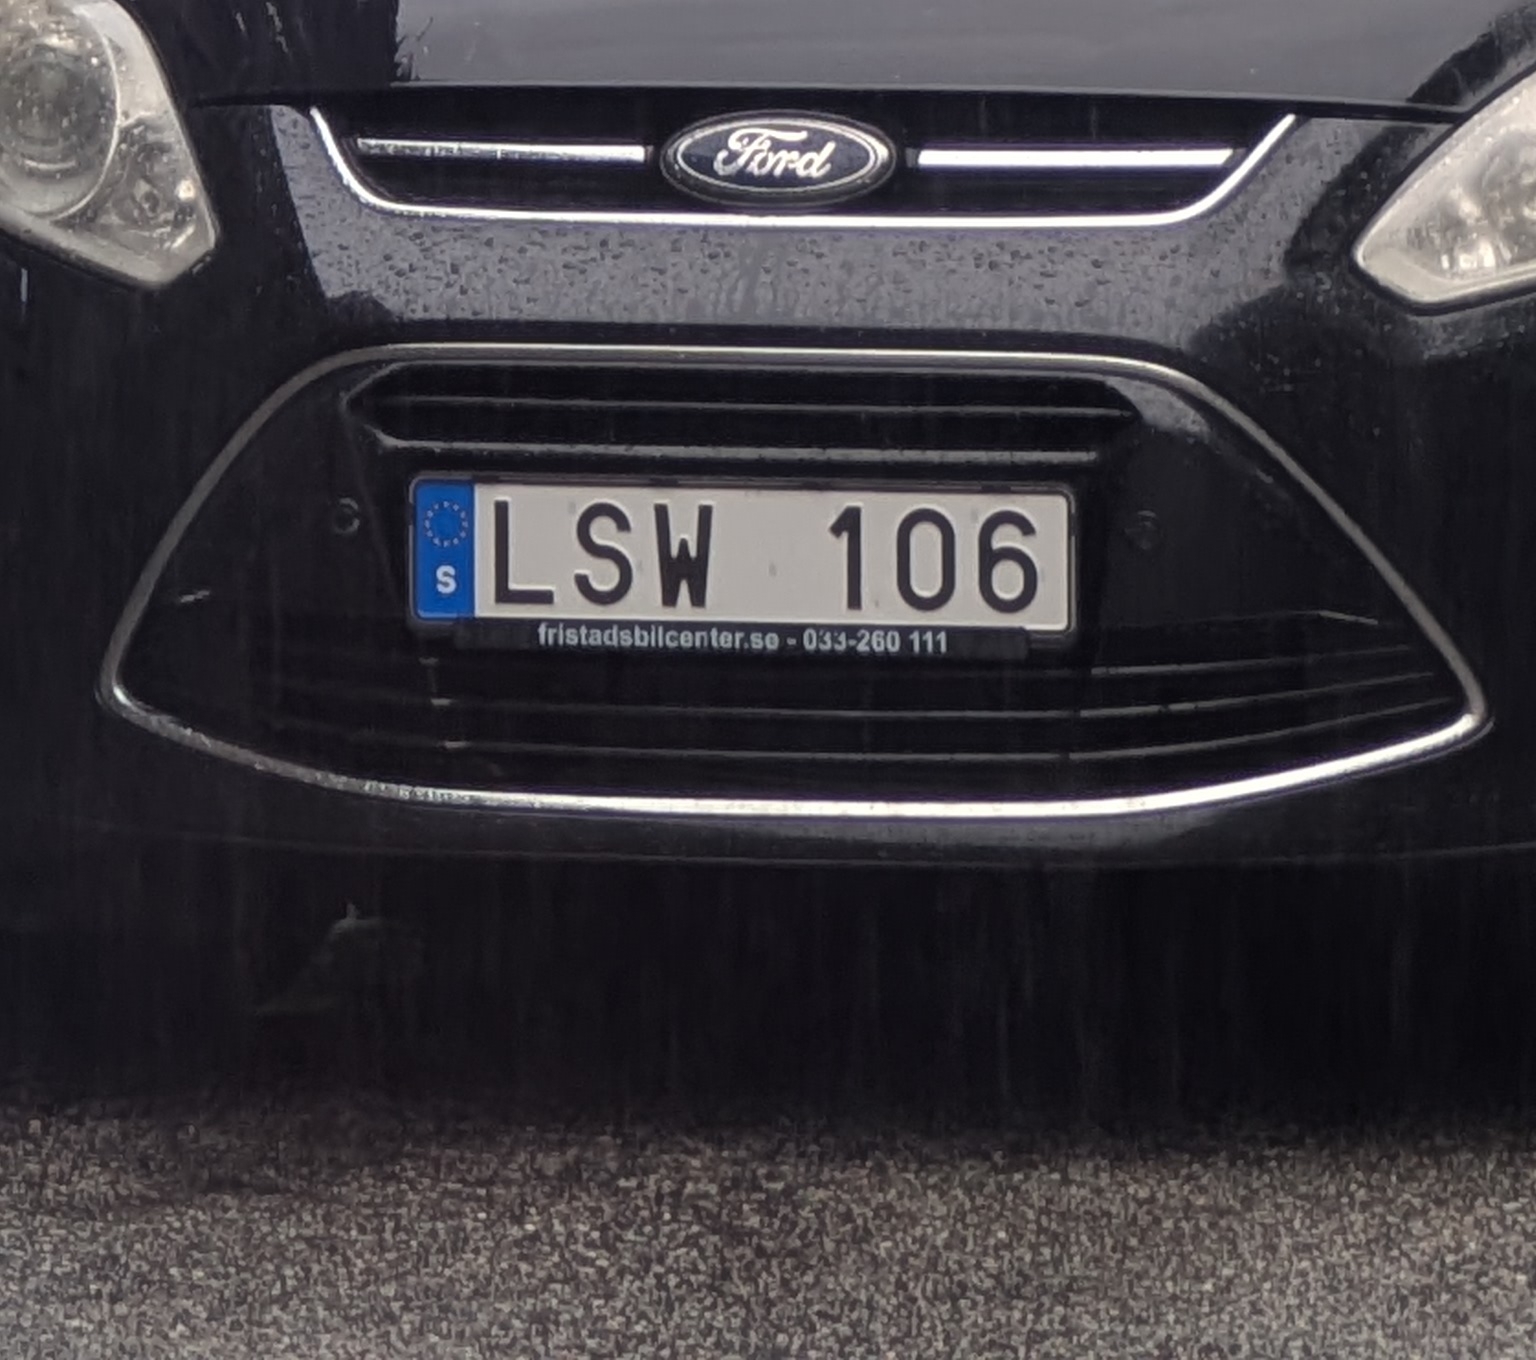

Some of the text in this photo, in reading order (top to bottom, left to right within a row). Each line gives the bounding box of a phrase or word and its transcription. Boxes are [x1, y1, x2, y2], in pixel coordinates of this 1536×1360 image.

[713, 128, 837, 178] Ford
[494, 500, 1039, 614] LSW 106
[435, 565, 457, 594] S
[537, 621, 780, 650] fristadsbilcenter.se
[803, 629, 901, 654] 033-260
[909, 631, 948, 655] 111
